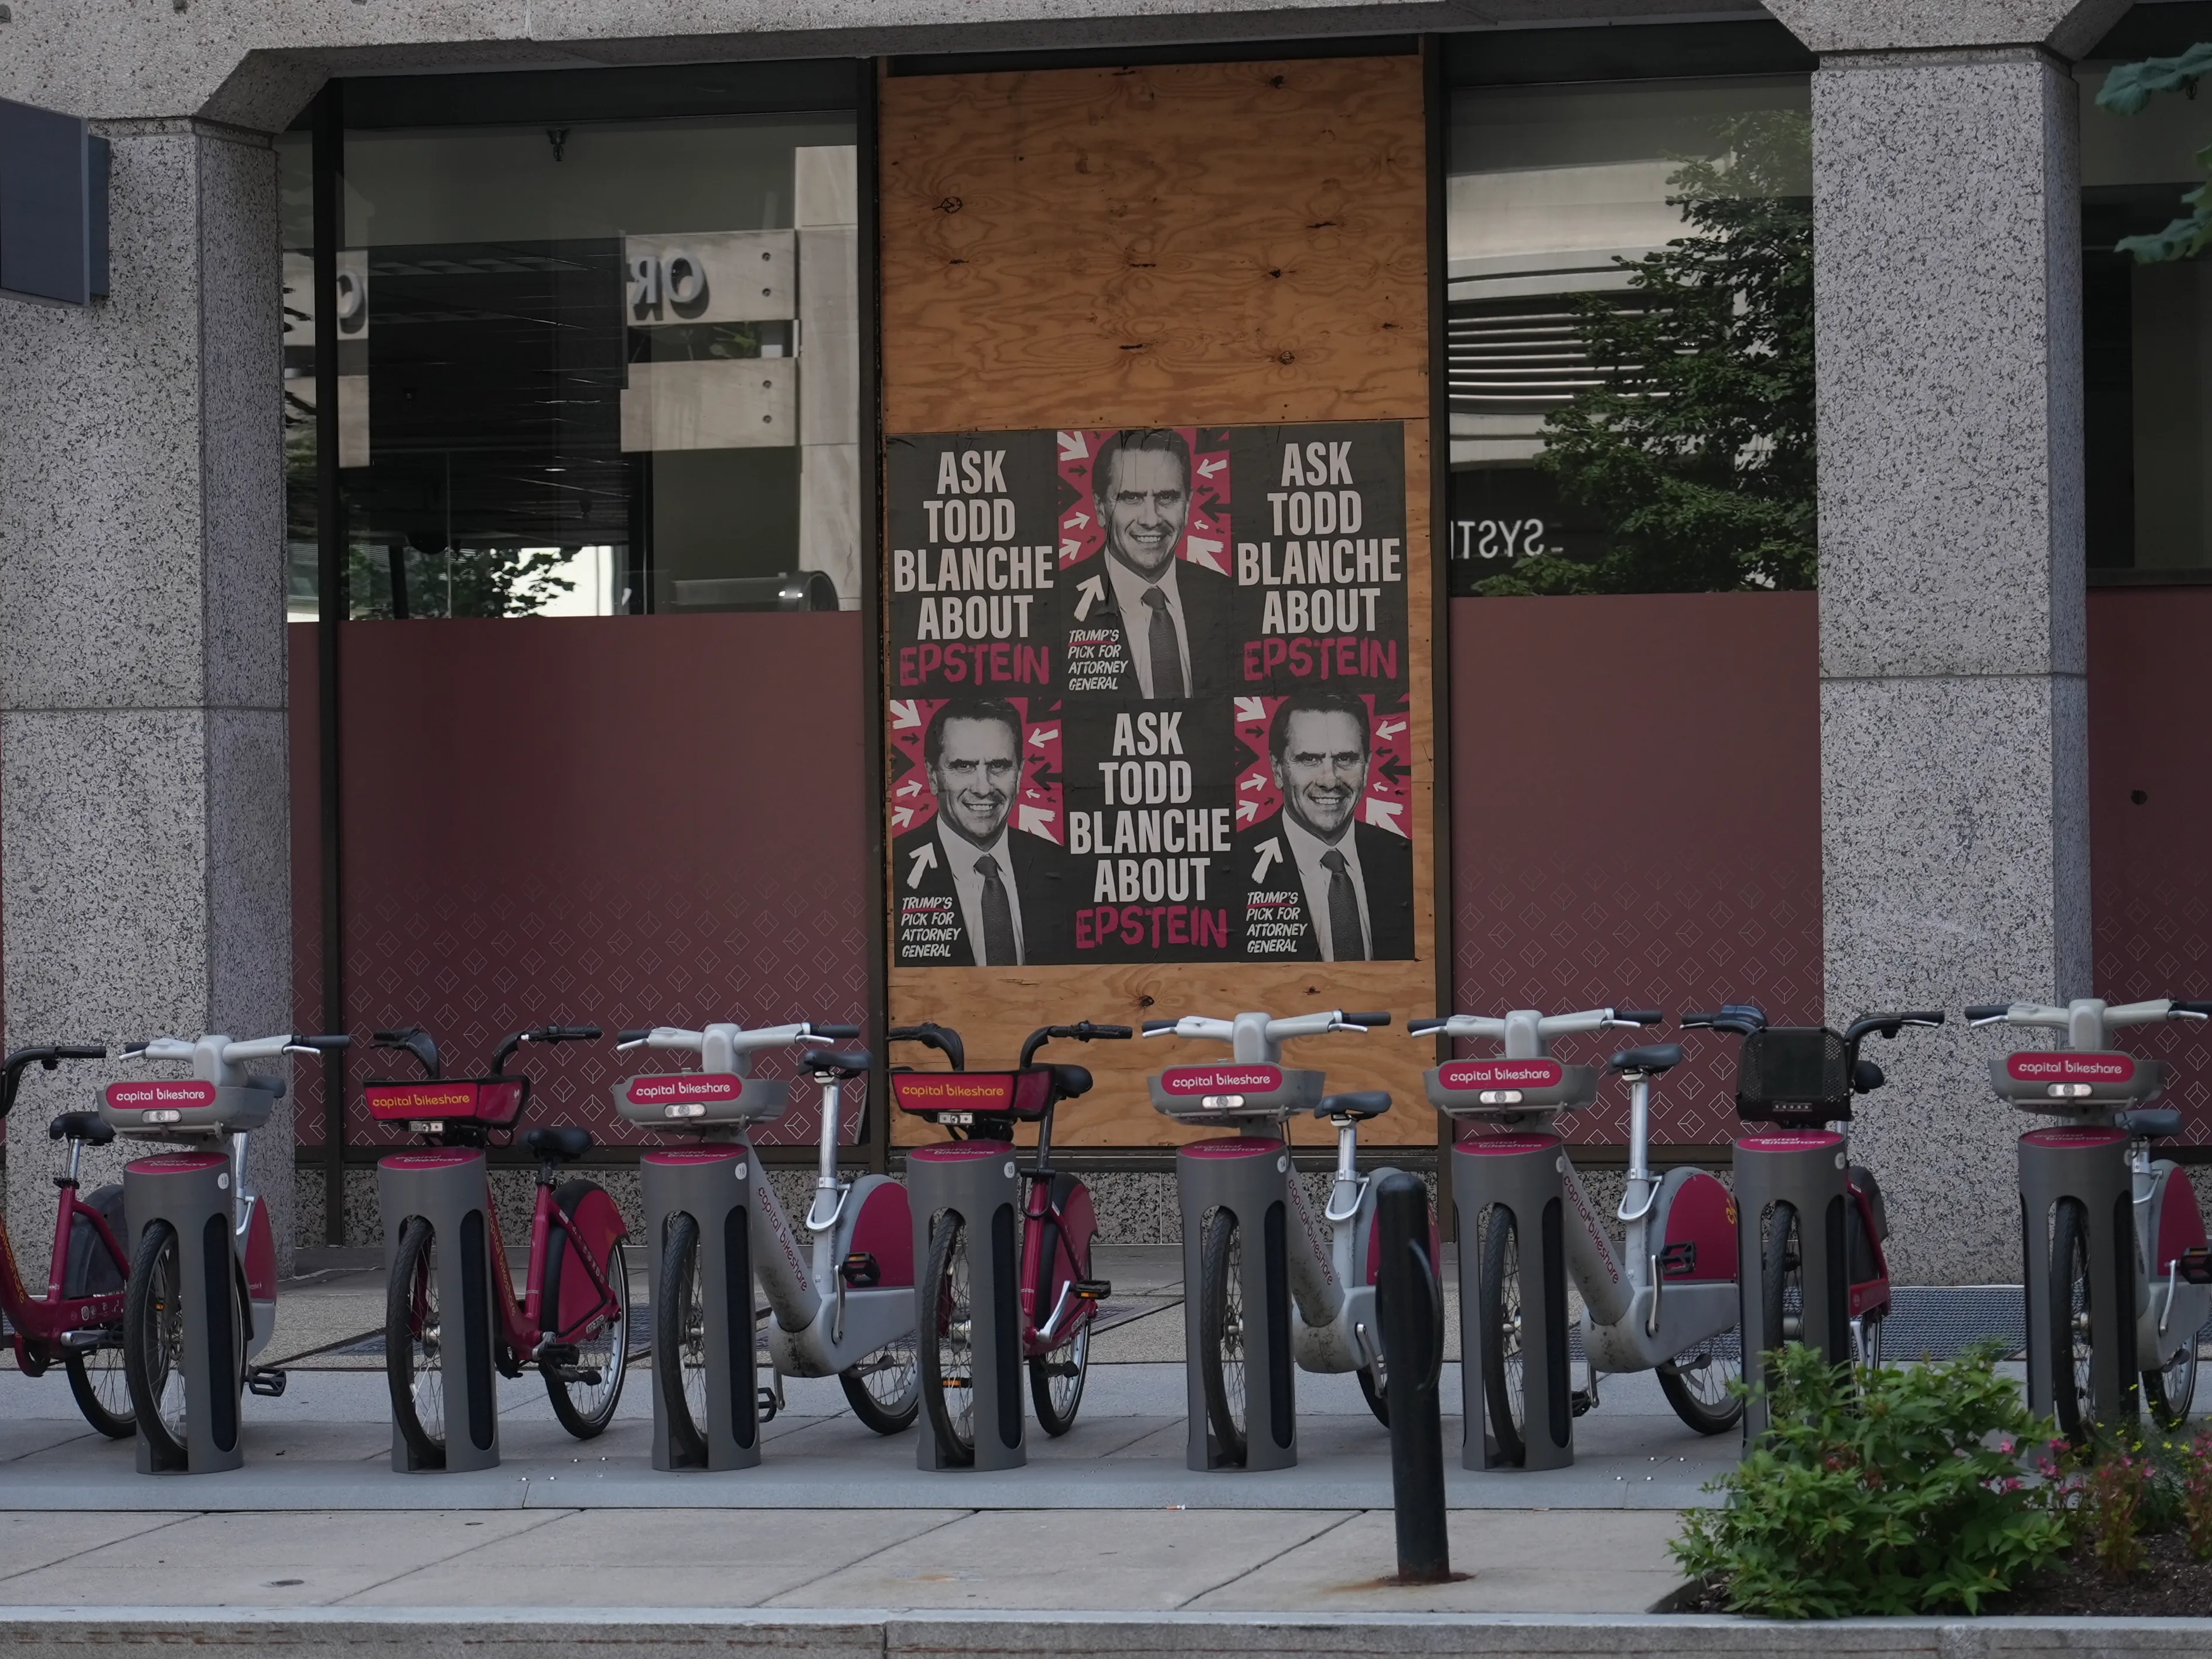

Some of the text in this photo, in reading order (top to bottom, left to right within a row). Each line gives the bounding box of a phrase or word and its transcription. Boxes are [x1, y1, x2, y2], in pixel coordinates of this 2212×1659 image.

[937, 450, 1007, 494] ASK
[1281, 442, 1353, 486] ASK
[923, 499, 1015, 542] TODD
[1267, 491, 1361, 535] TODD
[895, 546, 1053, 592] BLANCHE
[1238, 538, 1401, 585] BLANCHE
[917, 595, 1033, 640] ABOUT
[1262, 588, 1380, 634] ABOUT
[1070, 629, 1119, 643] TRUMP'S
[900, 643, 1049, 686] EPSTEIN
[1068, 644, 1121, 659] PICK FOR
[1244, 637, 1398, 681] EPSTEIN
[1069, 660, 1128, 675] ATTORNEY
[1069, 677, 1118, 690] GENERAL
[1112, 712, 1183, 756] ASK
[1099, 761, 1192, 804] TODD
[1070, 808, 1231, 854] BLANCHE
[1094, 858, 1210, 902] ABOUT
[903, 897, 952, 910] TRUMP'S
[1248, 892, 1298, 905] TRUMP'S
[901, 912, 954, 926] PICK FOR
[1077, 905, 1227, 948] EPSTEIN
[1247, 907, 1300, 921] PICK FOR
[902, 928, 961, 941] ATTORNEY
[1247, 923, 1308, 937] ATTORNEY
[902, 944, 951, 957] GENERAL
[1248, 939, 1297, 953] GENERAL
[1173, 1074, 1270, 1089] capital bikeshare
[1450, 1068, 1550, 1083] capital bikeshare
[2019, 1060, 2122, 1074] capital bikeshare
[117, 1088, 204, 1102] capital bikeshare
[373, 1094, 470, 1108] capital bikeshare
[636, 1082, 730, 1098] capital bikeshare
[902, 1084, 1003, 1097] capital bikeshare
[758, 1187, 807, 1292] capital bikeshare
[1564, 1176, 1619, 1284] capital bikeshare
[1307, 1221, 1333, 1285] bikeshare
[499, 1252, 516, 1316] bikeshare
